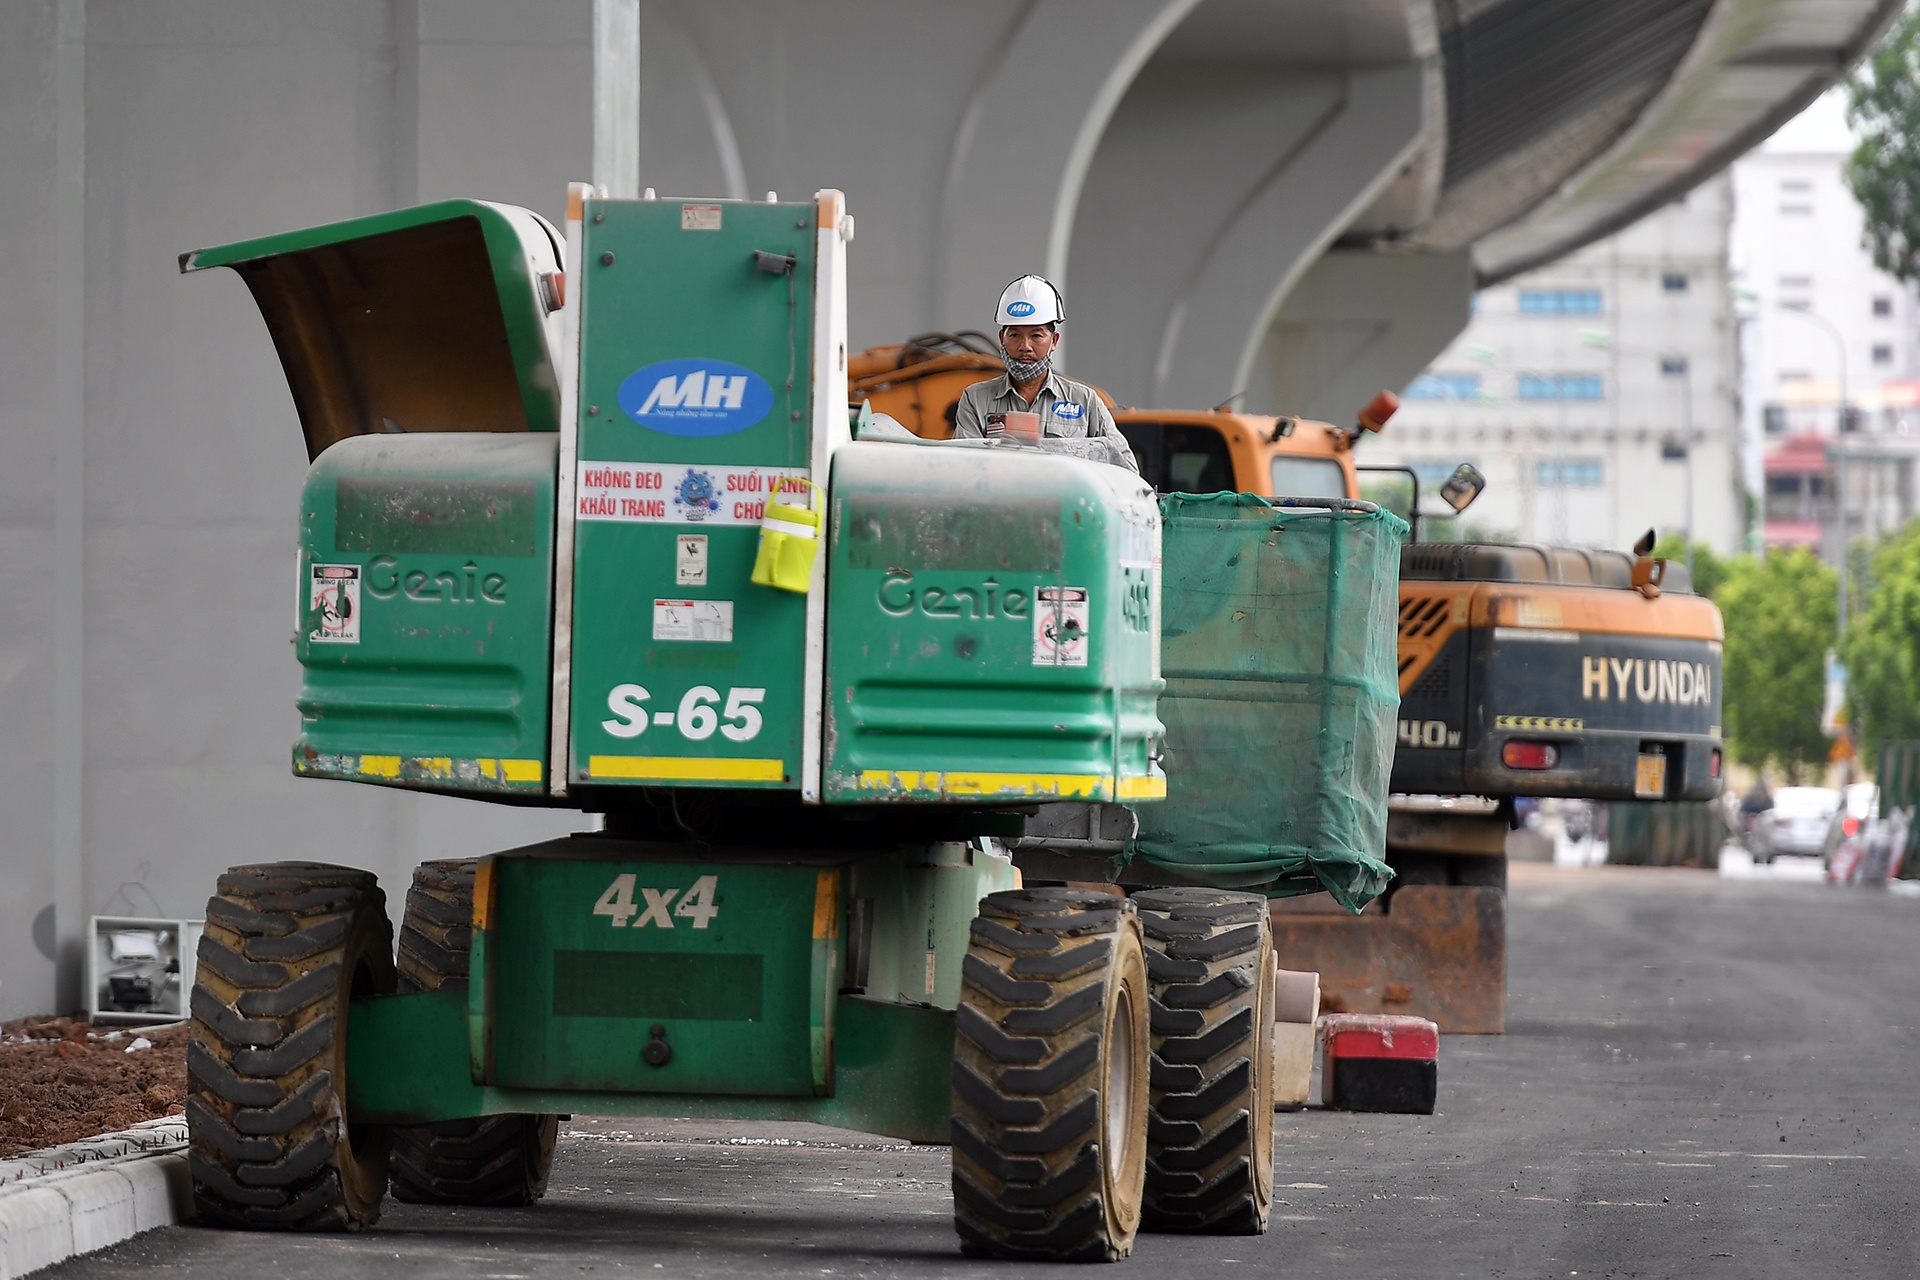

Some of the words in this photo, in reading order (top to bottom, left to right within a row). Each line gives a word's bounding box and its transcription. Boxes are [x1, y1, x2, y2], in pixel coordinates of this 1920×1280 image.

[1010, 304, 1030, 313] MH
[636, 370, 748, 414] MH
[1055, 403, 1080, 413] MH
[585, 467, 631, 488] KHÔNG
[636, 471, 662, 489] ĐEO
[727, 468, 763, 492] SUỐI
[580, 490, 617, 515] KHẨU
[621, 499, 665, 517] TRANG
[366, 555, 507, 604] Genie
[877, 567, 1029, 619] Genie
[1582, 656, 1711, 703] HYUNDAI
[602, 684, 766, 741] S-65
[593, 873, 719, 928] 4x4
